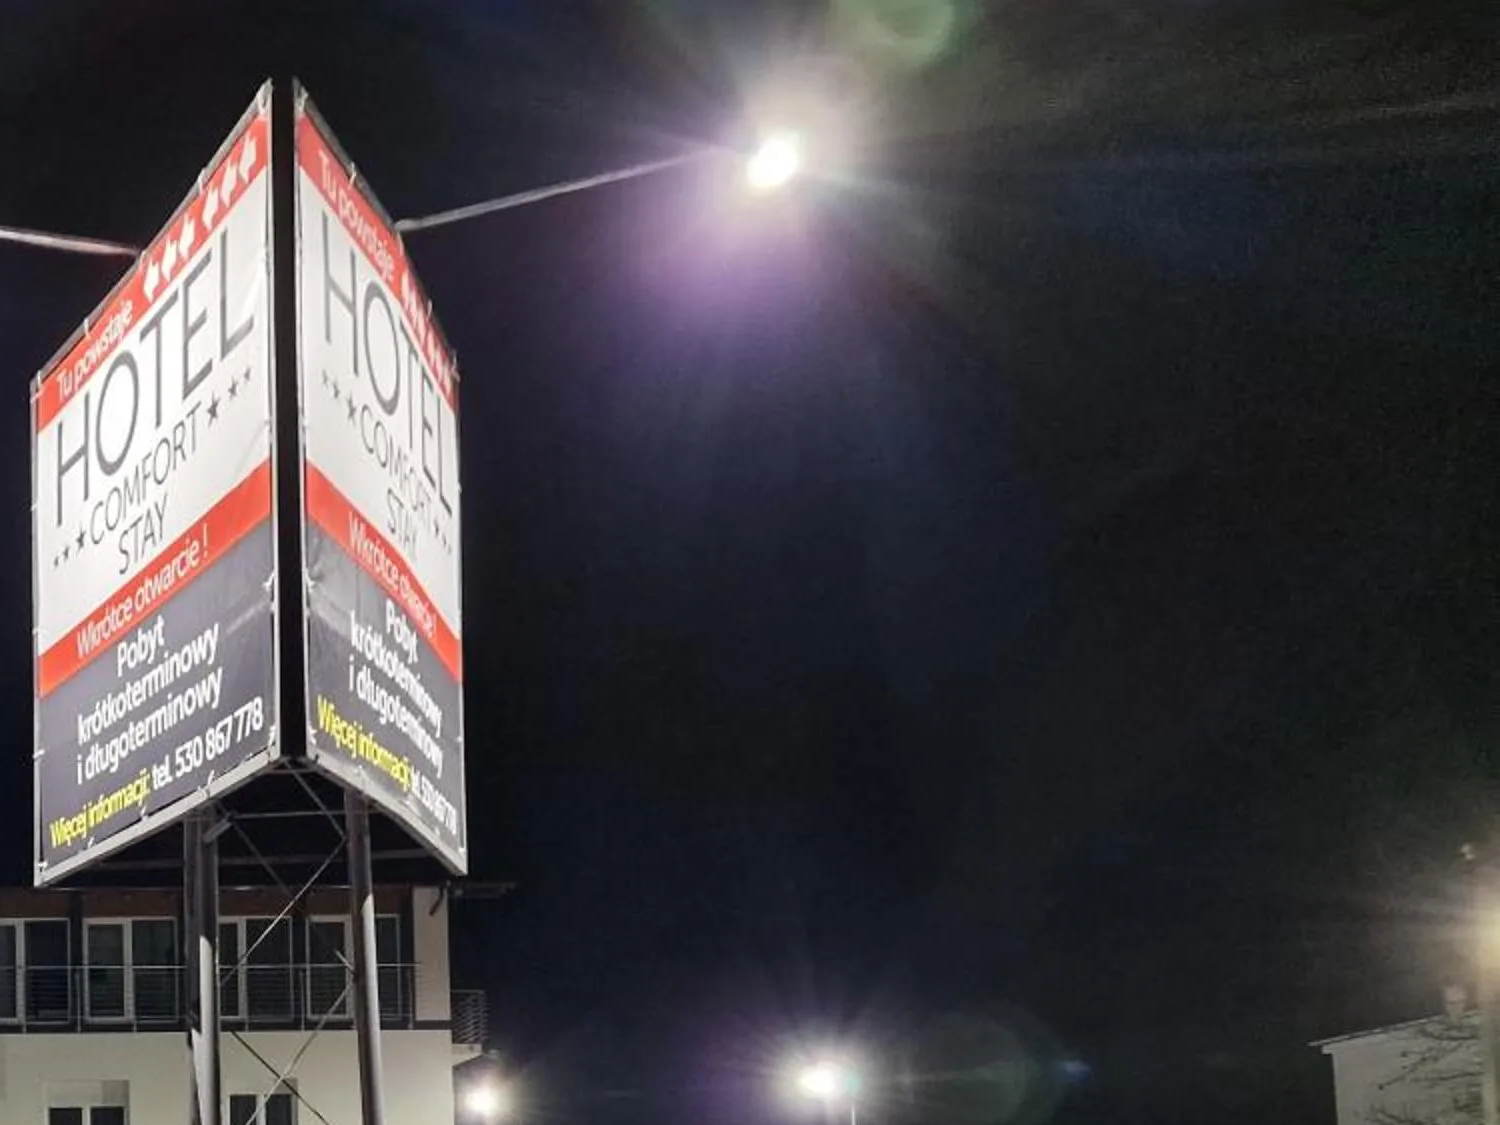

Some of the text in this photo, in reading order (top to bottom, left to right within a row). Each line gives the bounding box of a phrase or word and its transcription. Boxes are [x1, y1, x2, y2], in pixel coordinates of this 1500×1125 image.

[56, 226, 256, 527] HOTEL
[56, 368, 73, 401] Tu
[321, 210, 453, 518] HOTEL
[90, 401, 202, 545] COMFORT
[118, 491, 169, 575] STAY
[76, 596, 134, 660] Wkrótce
[134, 537, 201, 614] otwarcie
[117, 615, 165, 677] Pobyt
[77, 623, 220, 746] krótkoterminowy
[77, 667, 224, 785] i długoterminowy
[152, 754, 174, 791] tel.
[175, 736, 203, 778] 530
[205, 714, 234, 760] 867
[234, 696, 264, 743] 778
